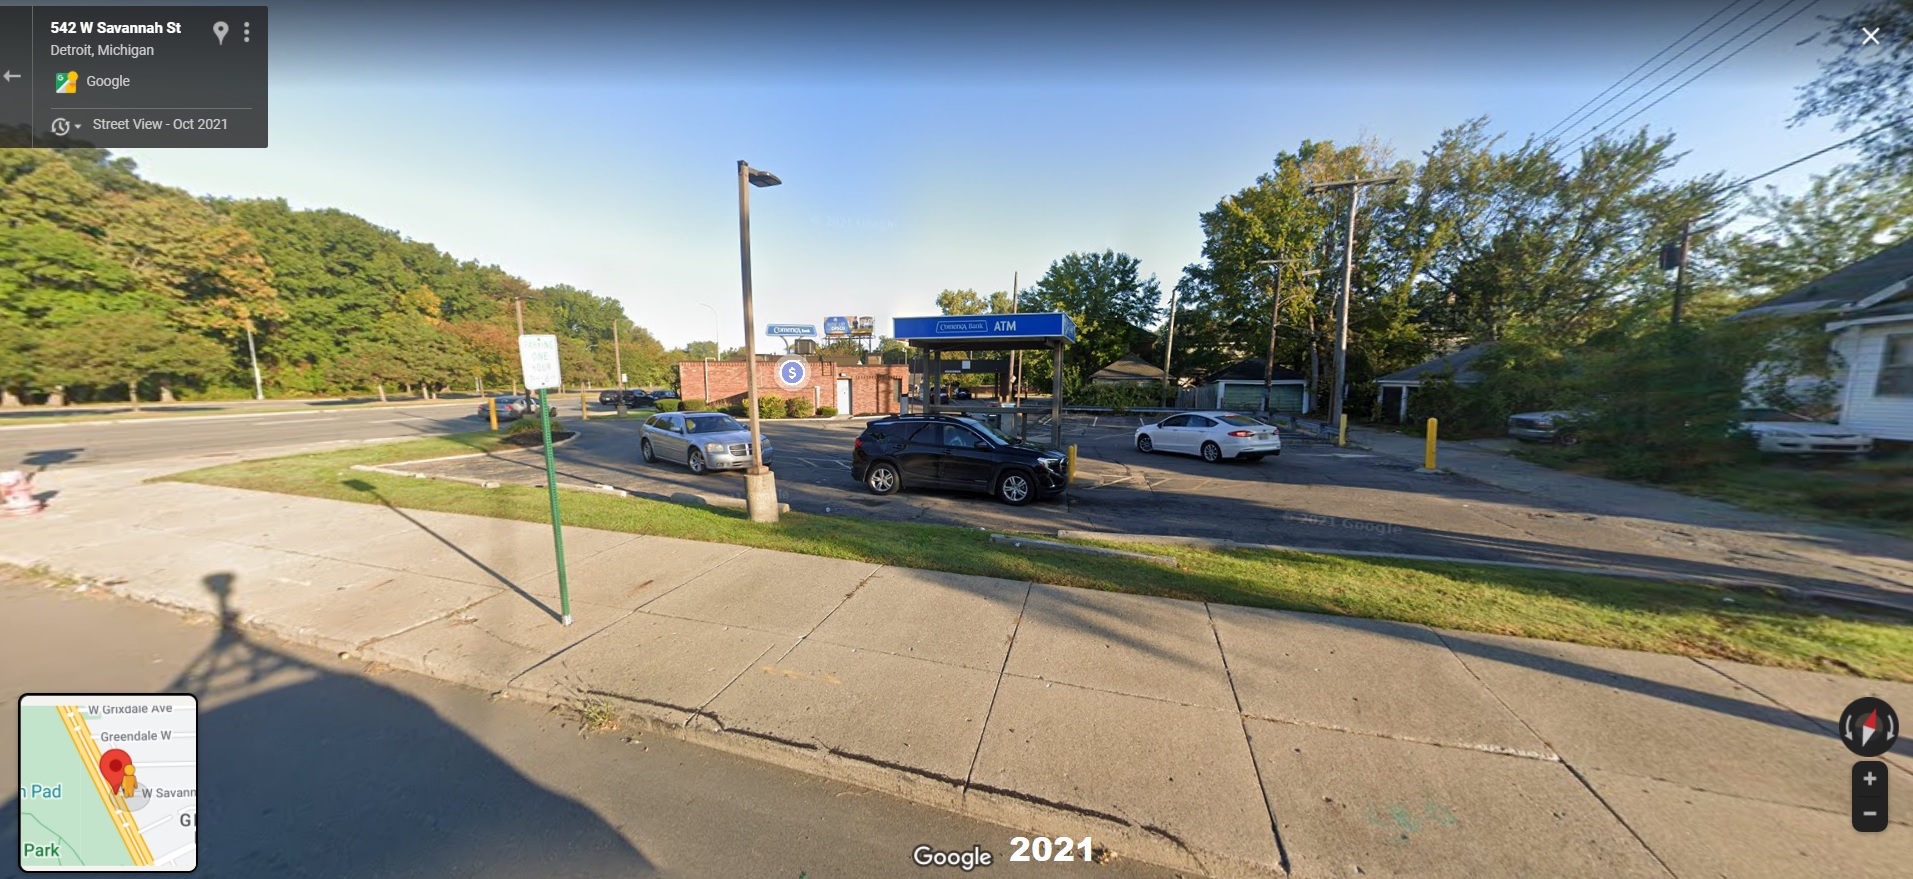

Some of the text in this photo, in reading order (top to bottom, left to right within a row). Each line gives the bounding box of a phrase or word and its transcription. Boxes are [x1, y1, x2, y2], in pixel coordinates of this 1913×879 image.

[968, 319, 984, 329] Bank
[993, 320, 1017, 332] ATM
[531, 351, 548, 361] ONE
